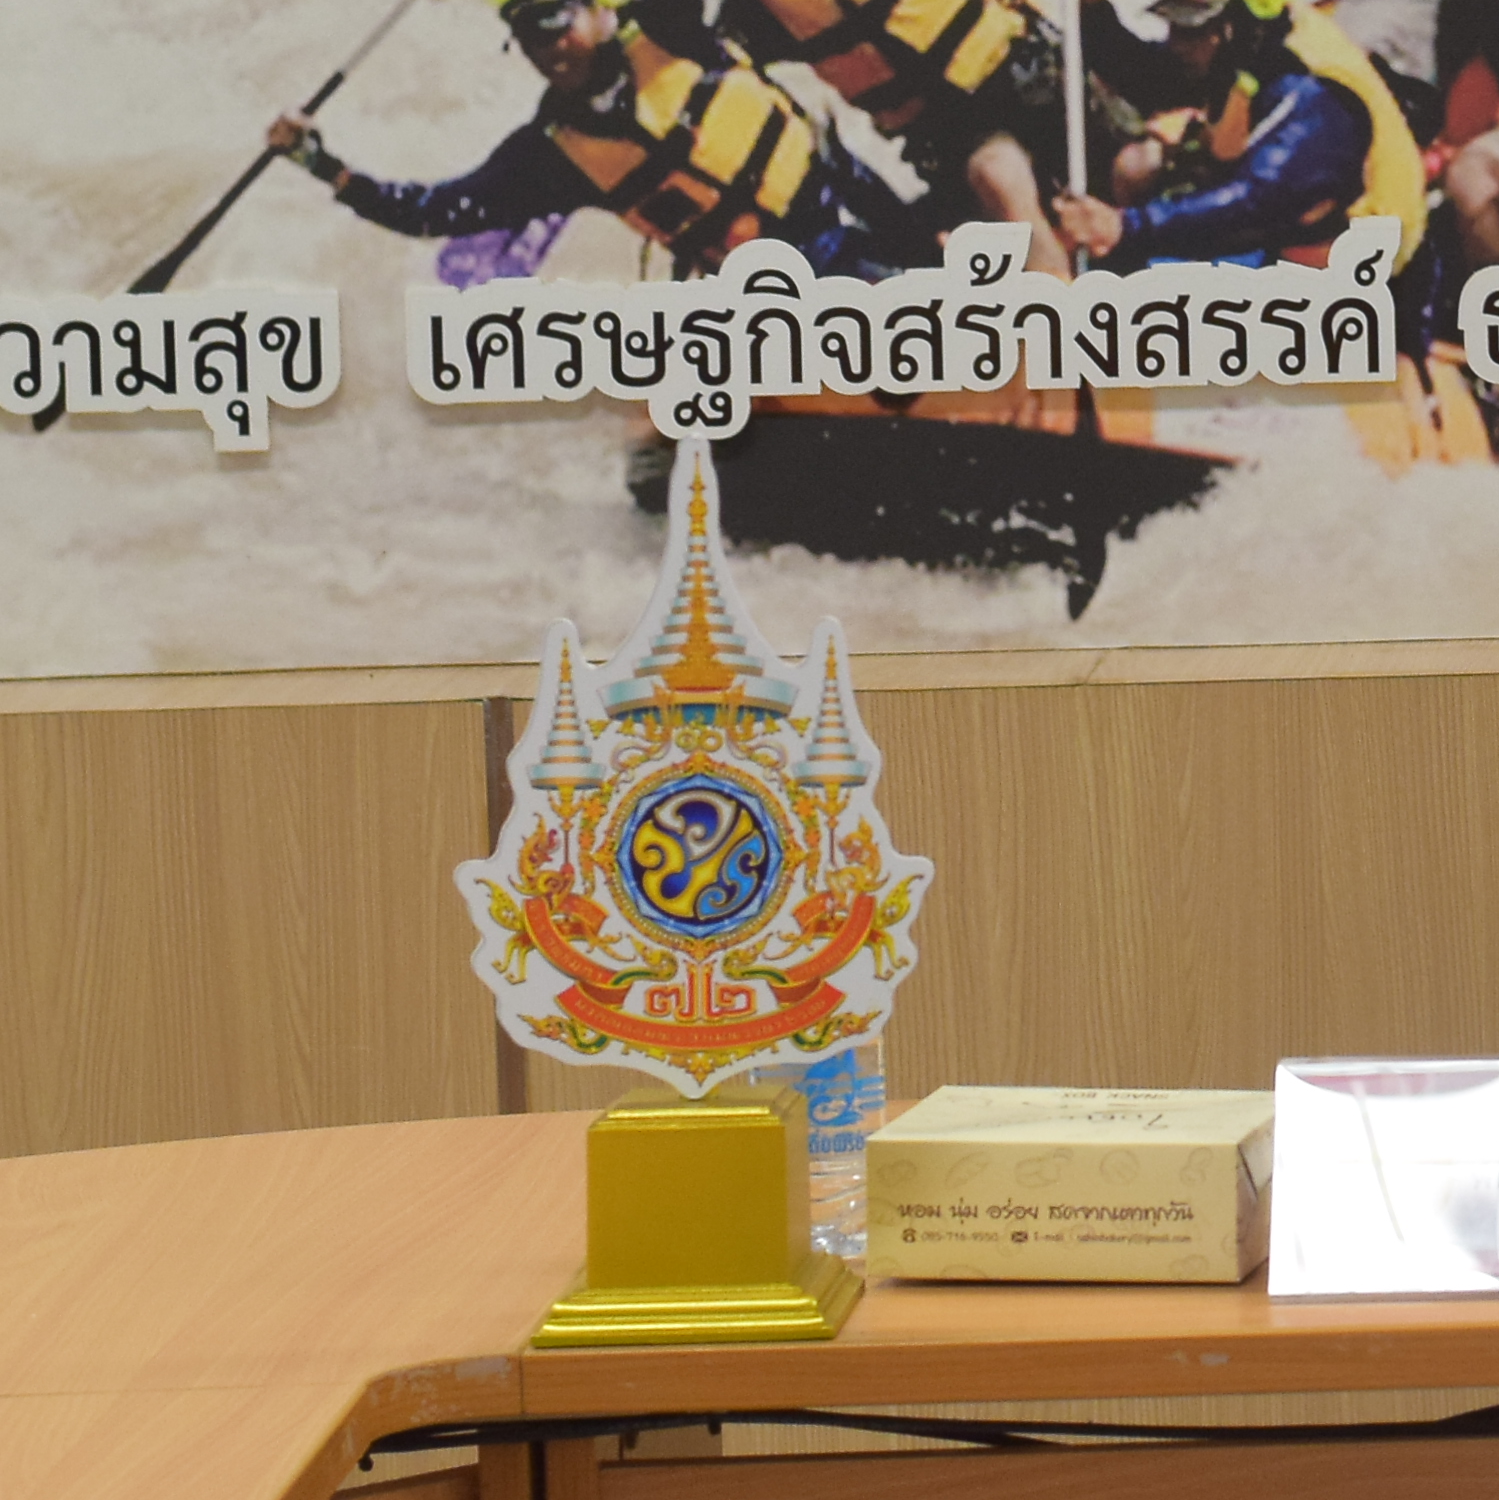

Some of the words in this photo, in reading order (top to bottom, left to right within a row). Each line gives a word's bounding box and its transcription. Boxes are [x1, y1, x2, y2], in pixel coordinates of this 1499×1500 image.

[431, 248, 1383, 426] เศรษฐกิจสร้างสรรค์
[898, 1204, 941, 1219] หอม
[950, 1197, 979, 1225] นุ่ม
[986, 1197, 1038, 1220] อร่อย
